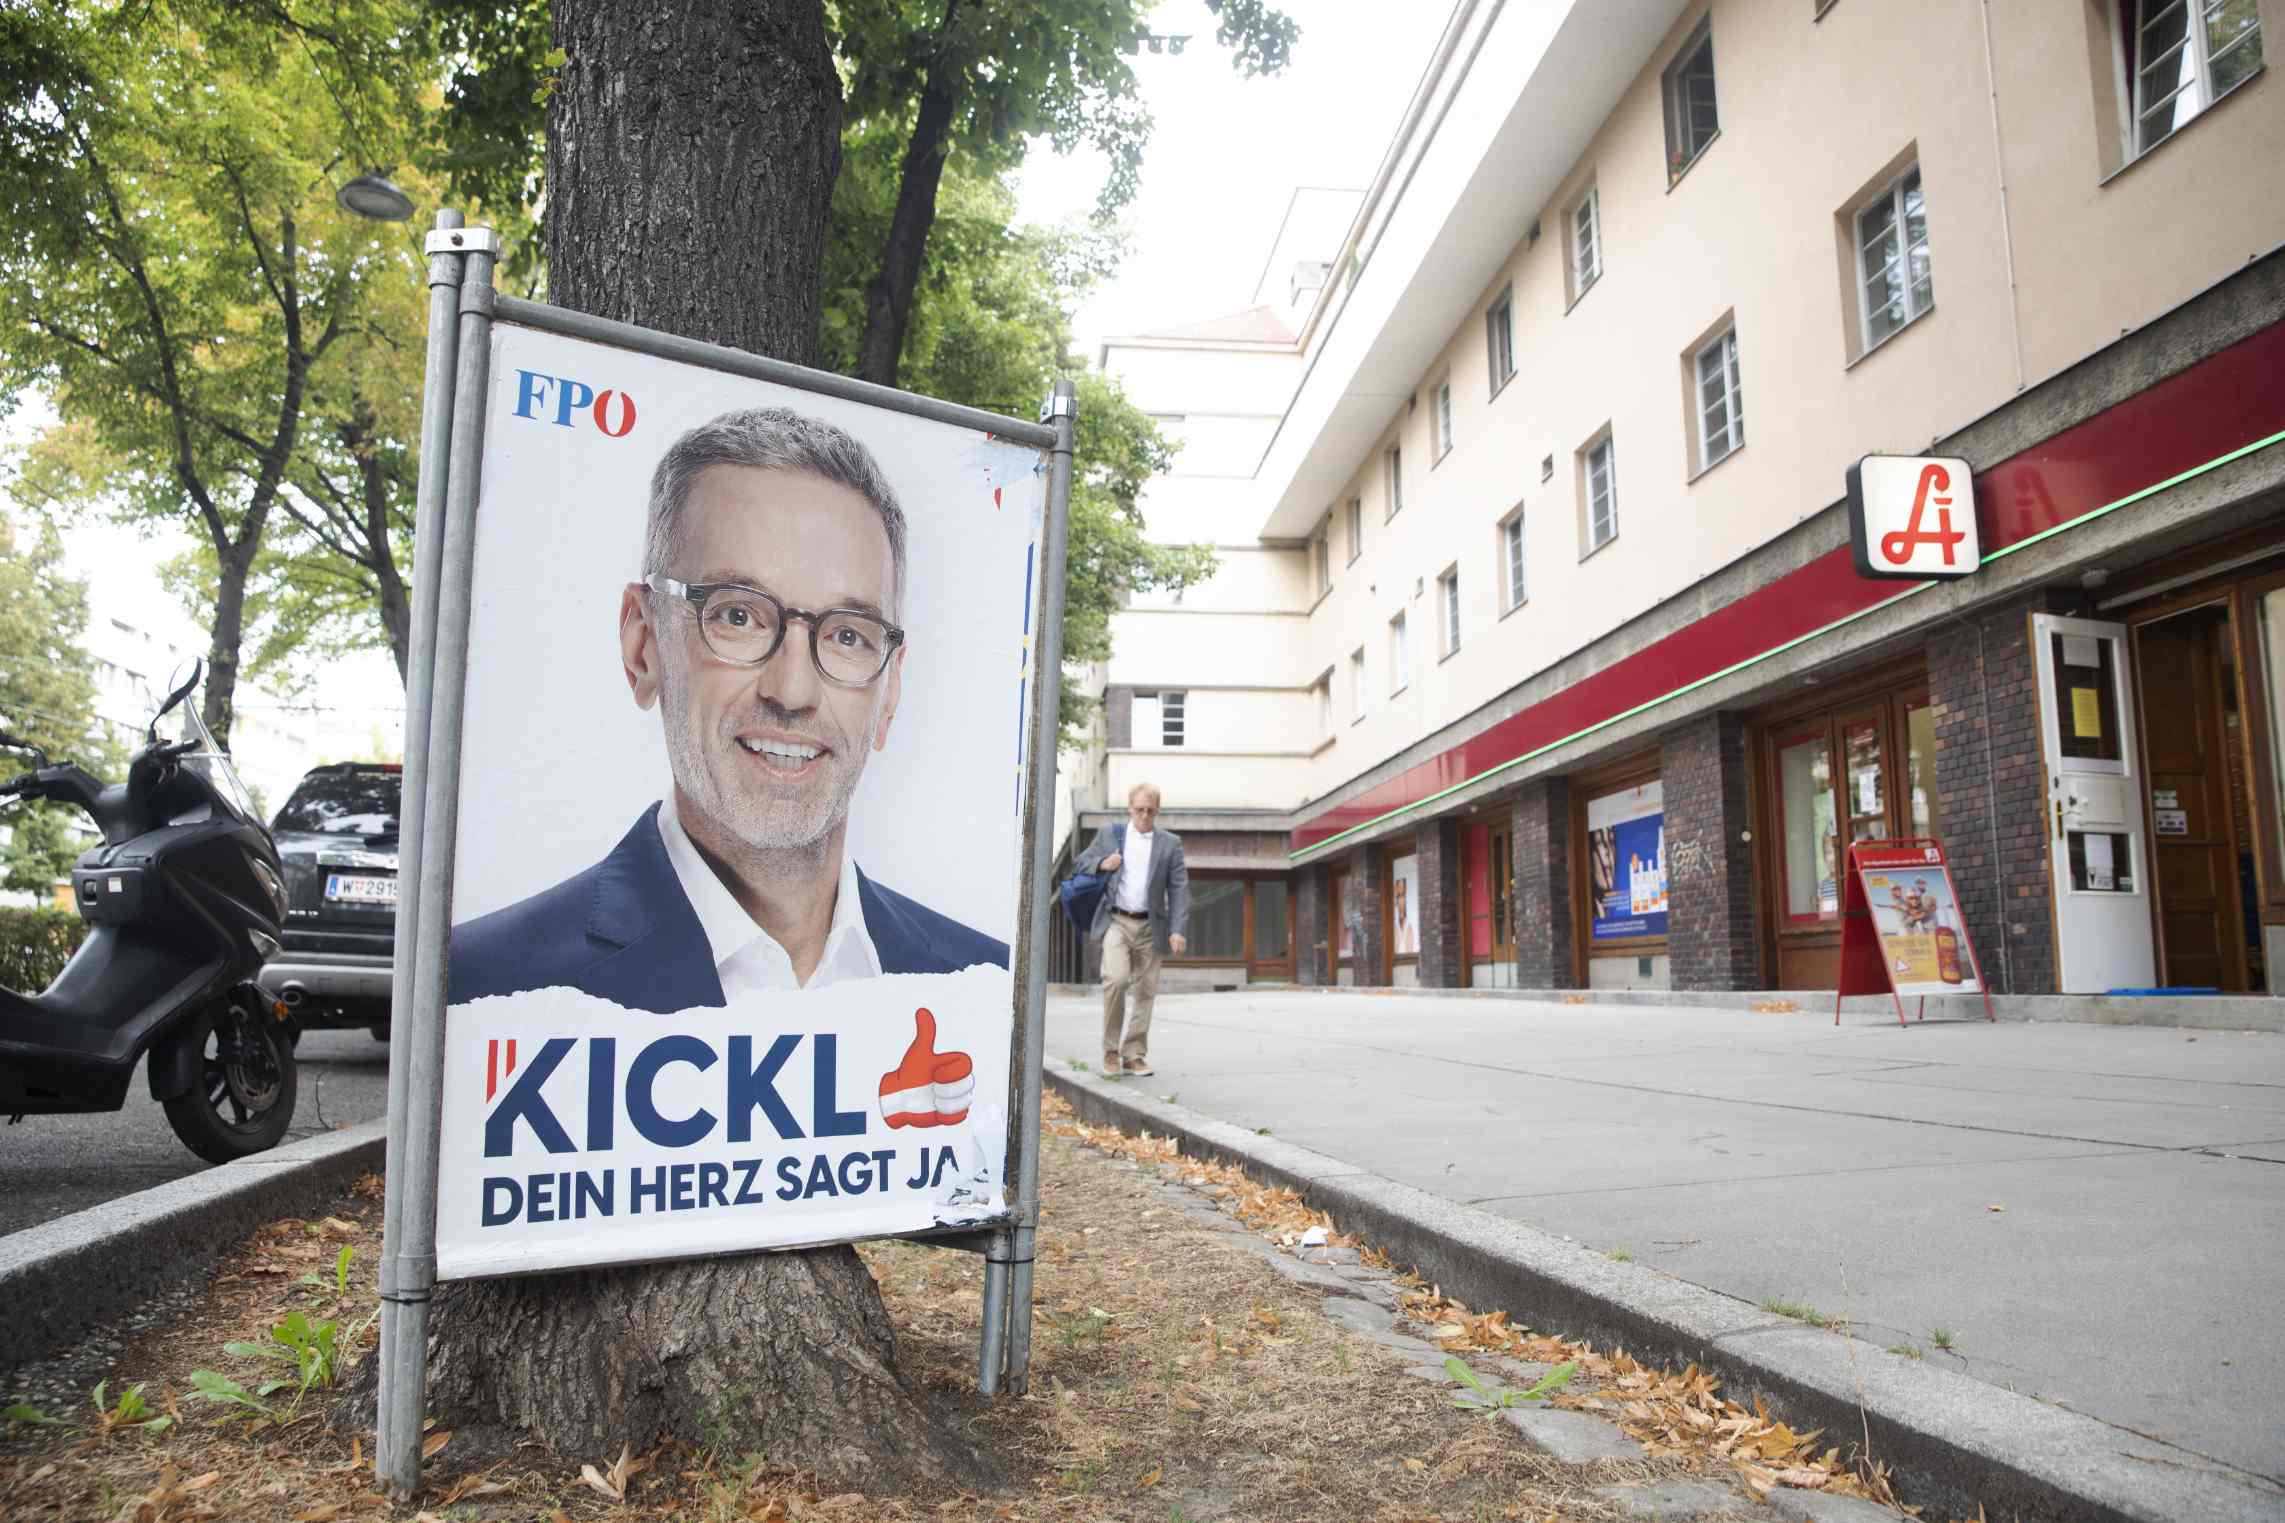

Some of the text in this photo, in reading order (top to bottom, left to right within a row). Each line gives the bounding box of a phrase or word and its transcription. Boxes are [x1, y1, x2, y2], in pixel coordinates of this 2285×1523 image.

[483, 1033, 867, 1158] KICKL
[481, 1146, 960, 1228] DEIN HERZ SAGT JA
